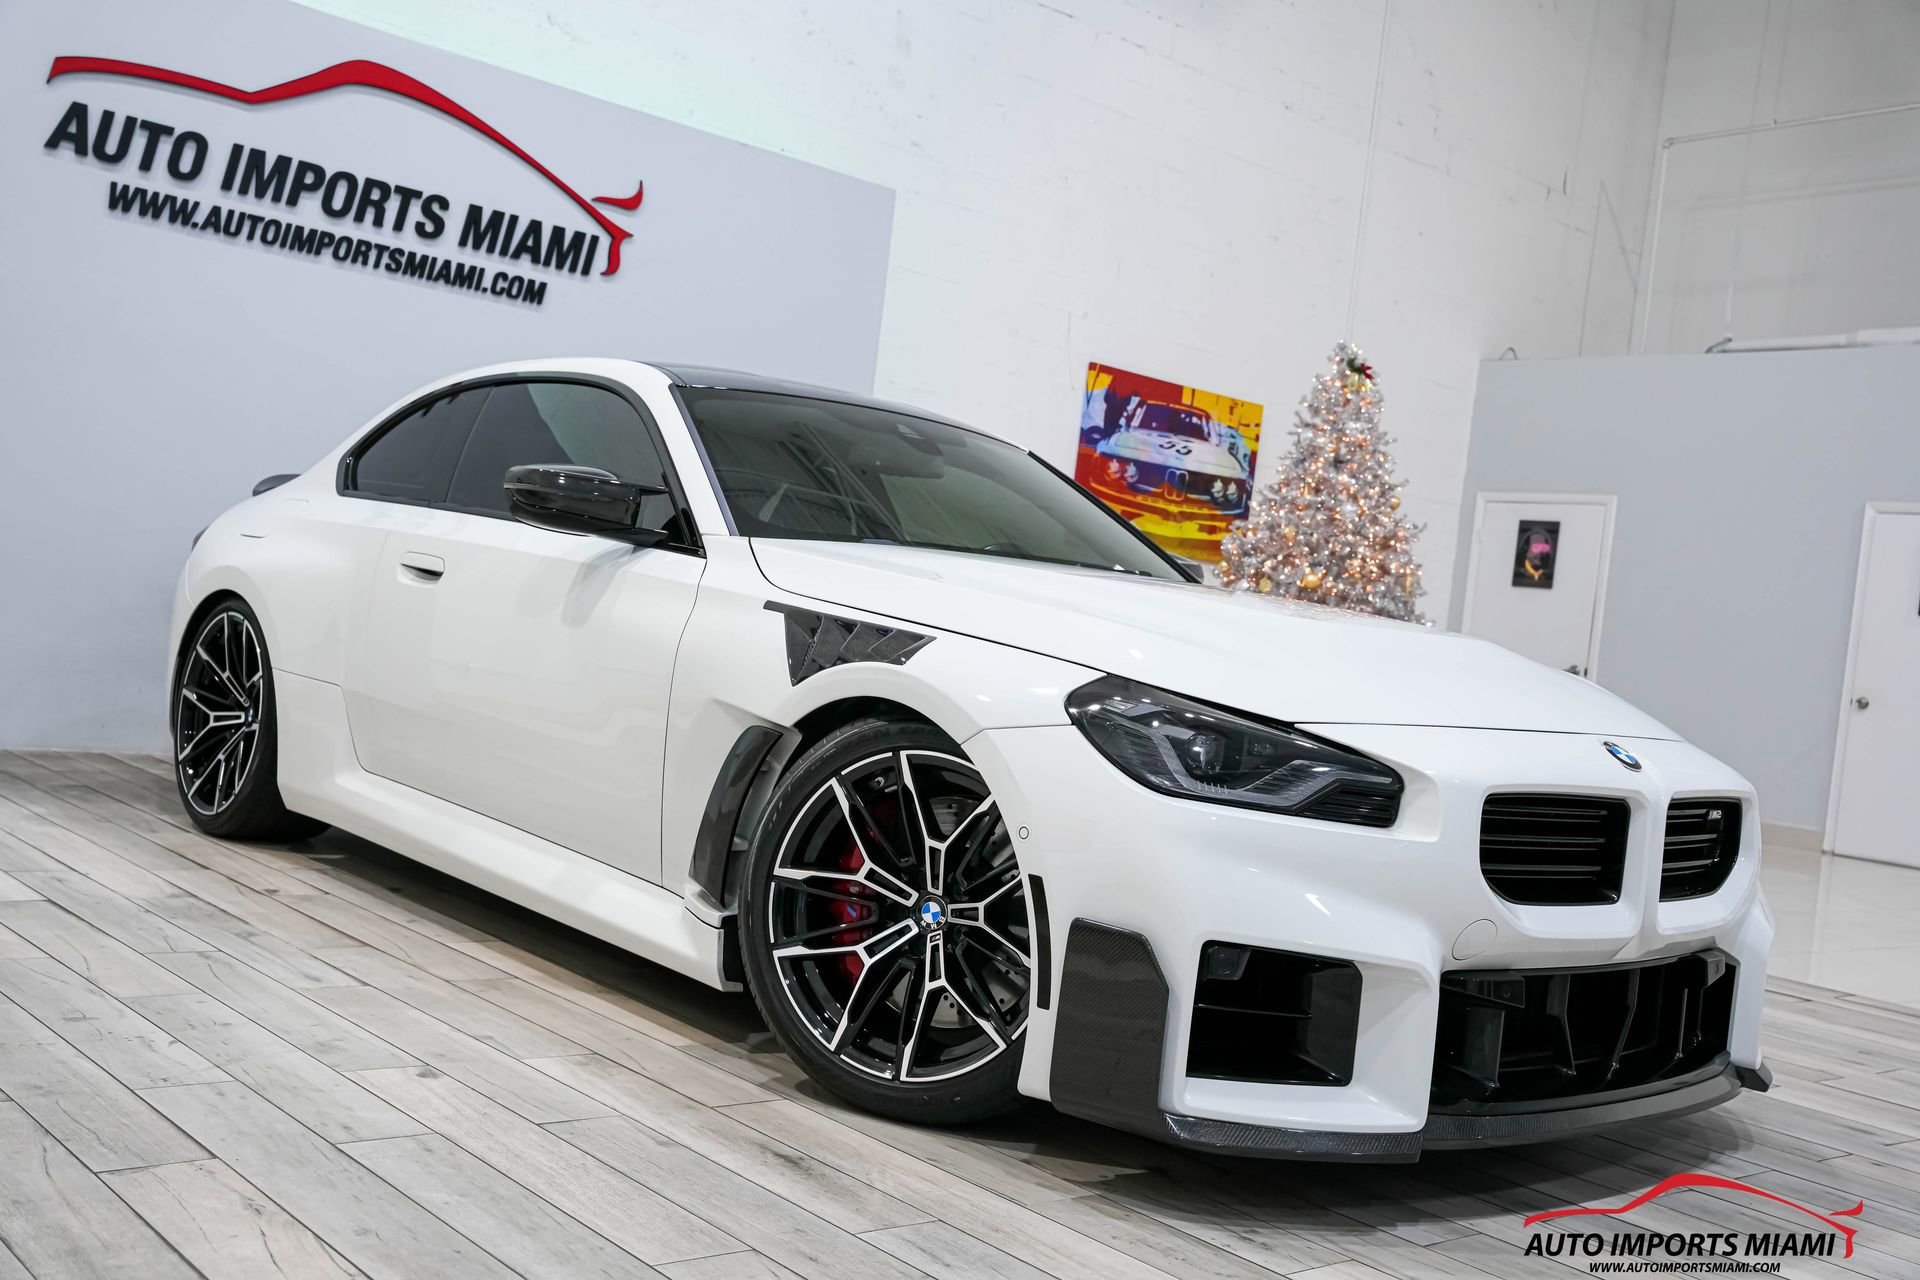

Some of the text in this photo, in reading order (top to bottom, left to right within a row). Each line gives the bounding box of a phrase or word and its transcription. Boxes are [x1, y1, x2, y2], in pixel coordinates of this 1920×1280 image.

[44, 102, 600, 277] AUTO IMPORTS MIAMI
[108, 182, 548, 306] WWW.AUTOIMPORTSMIAMI.COM
